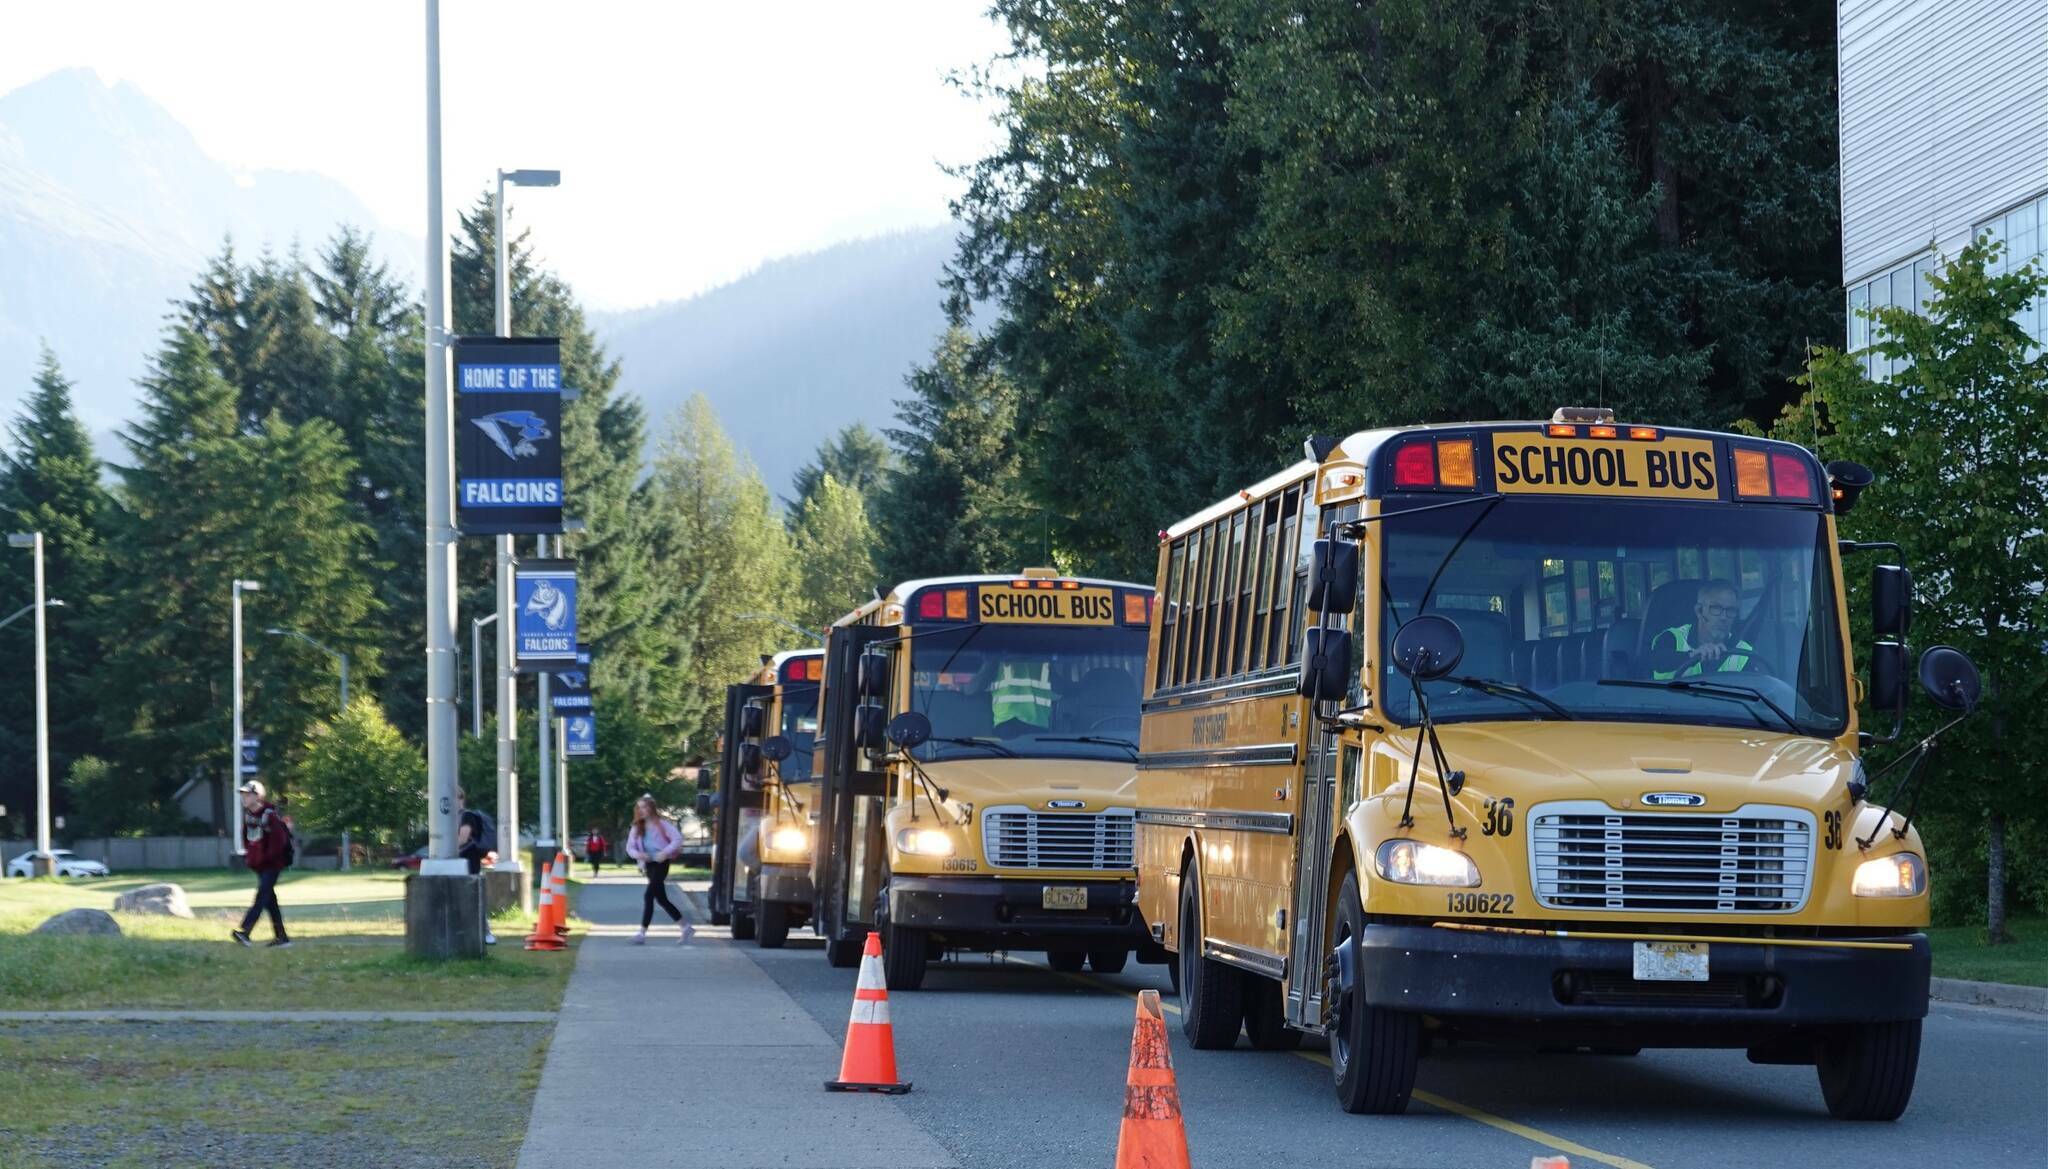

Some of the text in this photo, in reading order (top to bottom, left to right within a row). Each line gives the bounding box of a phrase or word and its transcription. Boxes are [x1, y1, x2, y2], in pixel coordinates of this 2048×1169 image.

[464, 368, 556, 388] HOME OF THE
[1497, 445, 1715, 490] SCHOOL BUS
[466, 482, 557, 503] FALCONS
[981, 593, 1112, 619] SCHOOL BUS
[524, 638, 568, 650] FALCONS
[553, 696, 589, 706] FALCONS
[1655, 795, 1692, 804] Thomas
[1482, 797, 1514, 837] 36
[1824, 810, 1842, 850] 36
[942, 858, 977, 872] 130615
[1447, 892, 1514, 914] 130622
